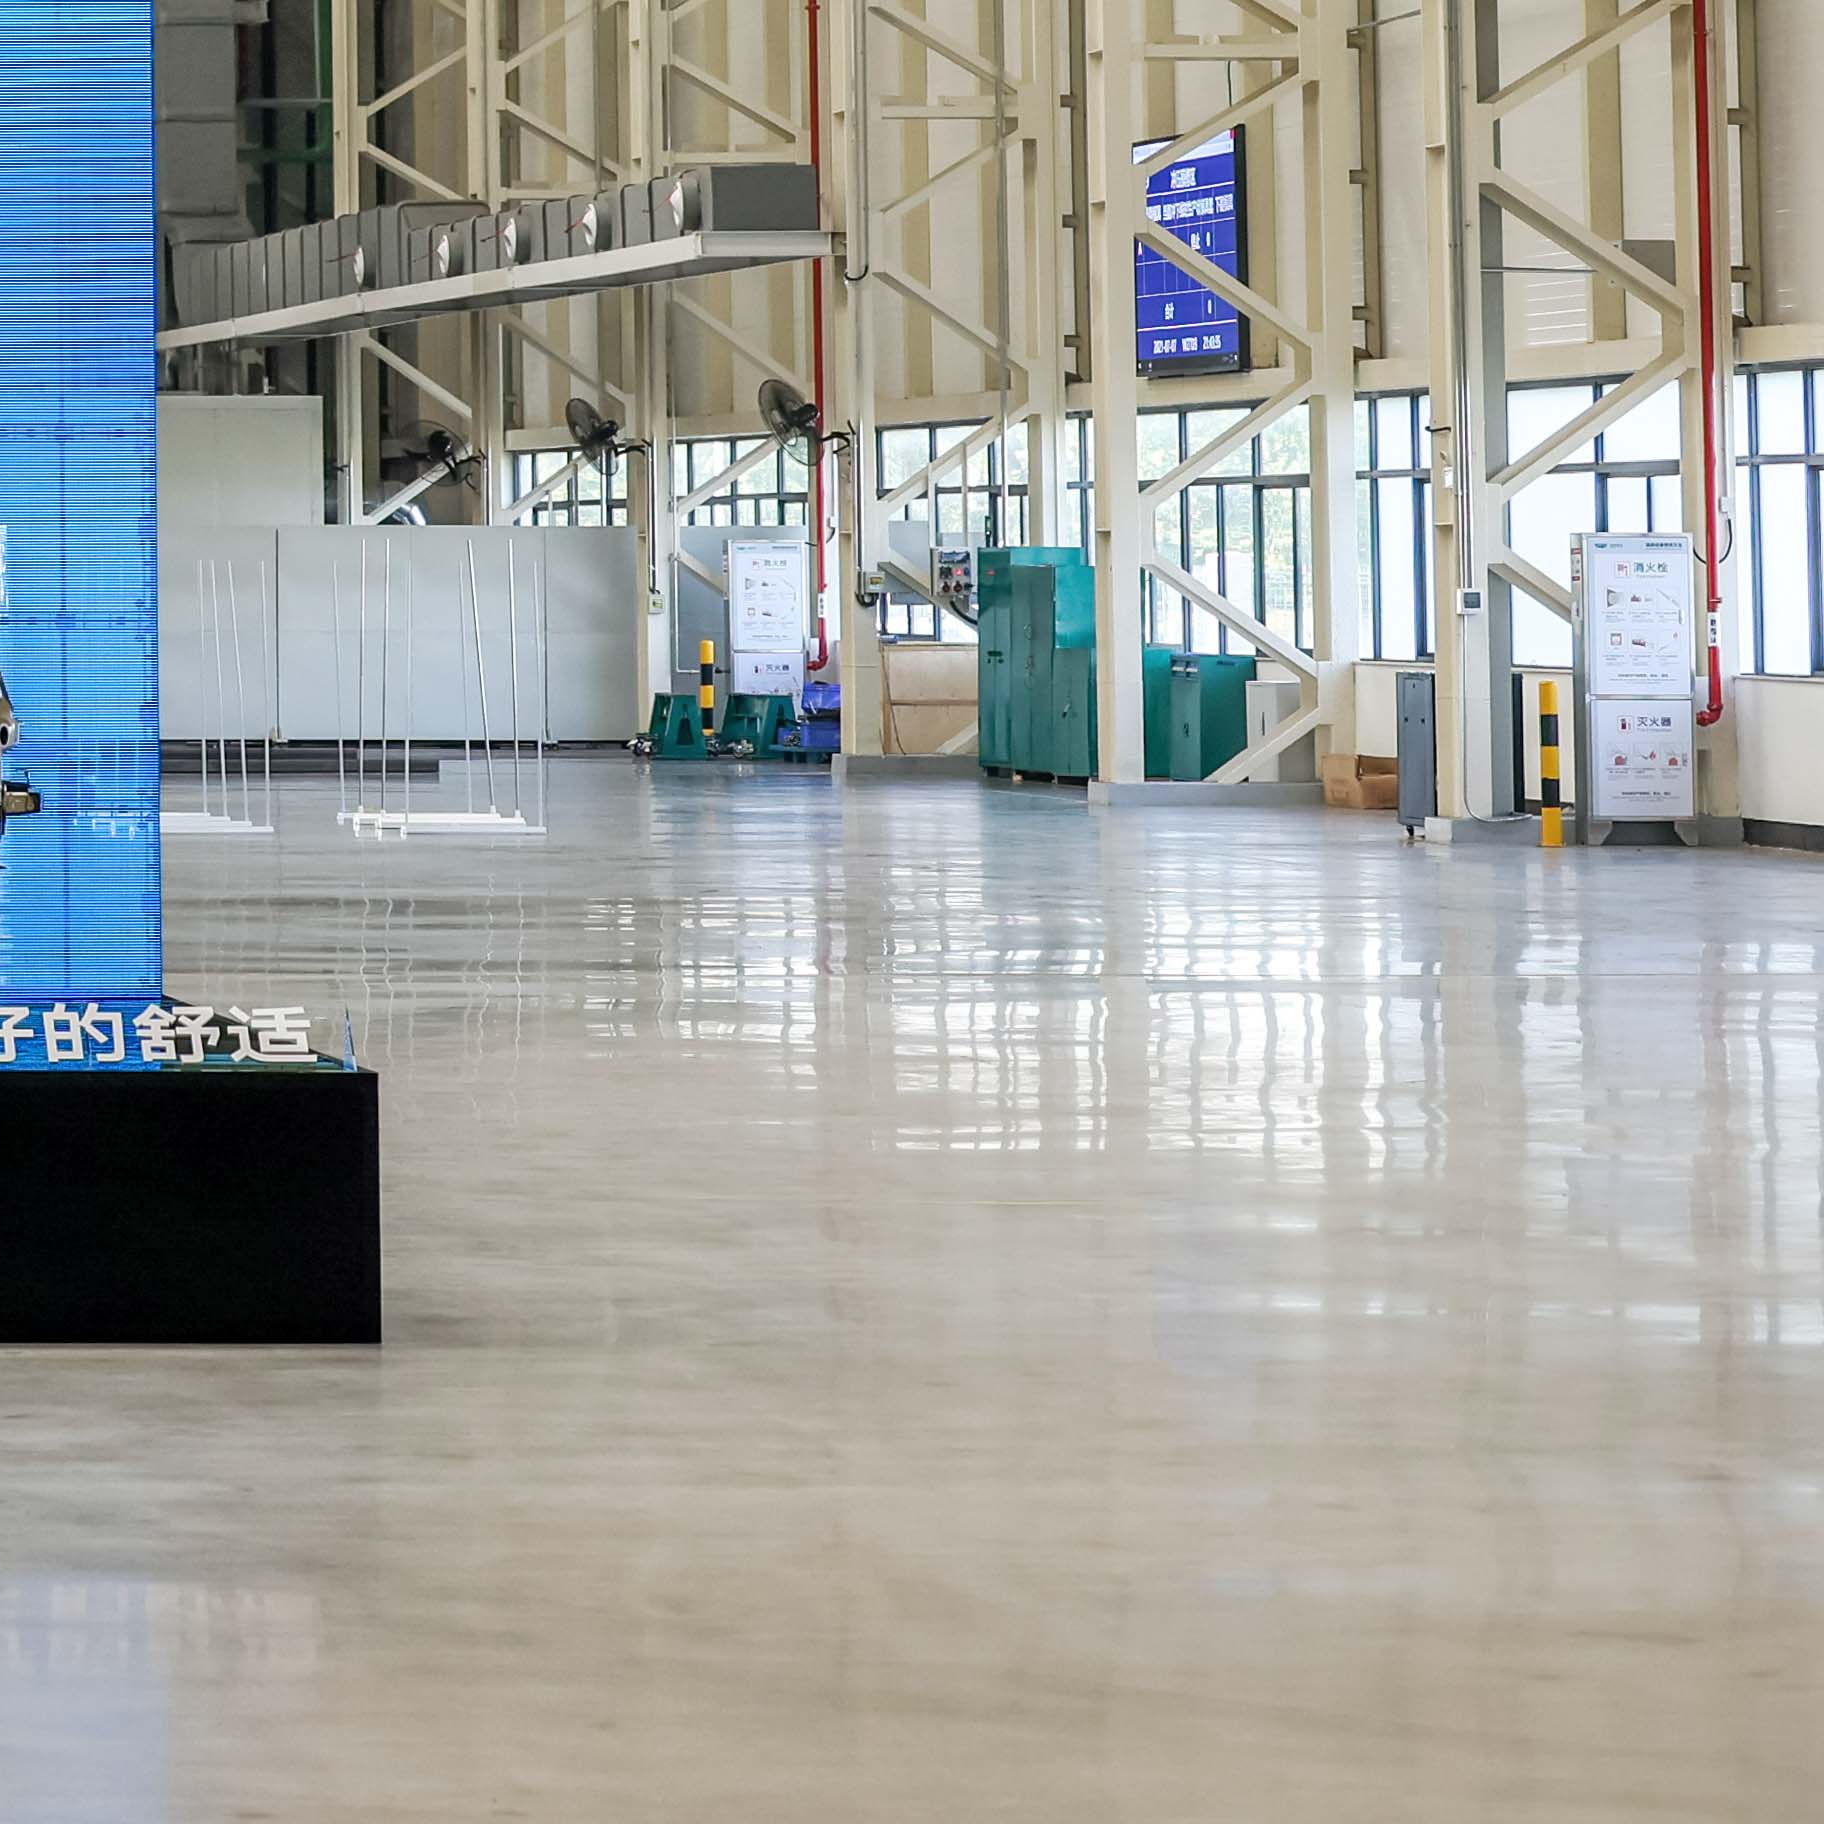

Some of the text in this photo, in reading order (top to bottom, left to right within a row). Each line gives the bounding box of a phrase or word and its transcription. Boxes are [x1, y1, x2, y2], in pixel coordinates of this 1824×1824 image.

[1633, 561, 1669, 573] 消火栓
[1637, 716, 1672, 727] 灭火器
